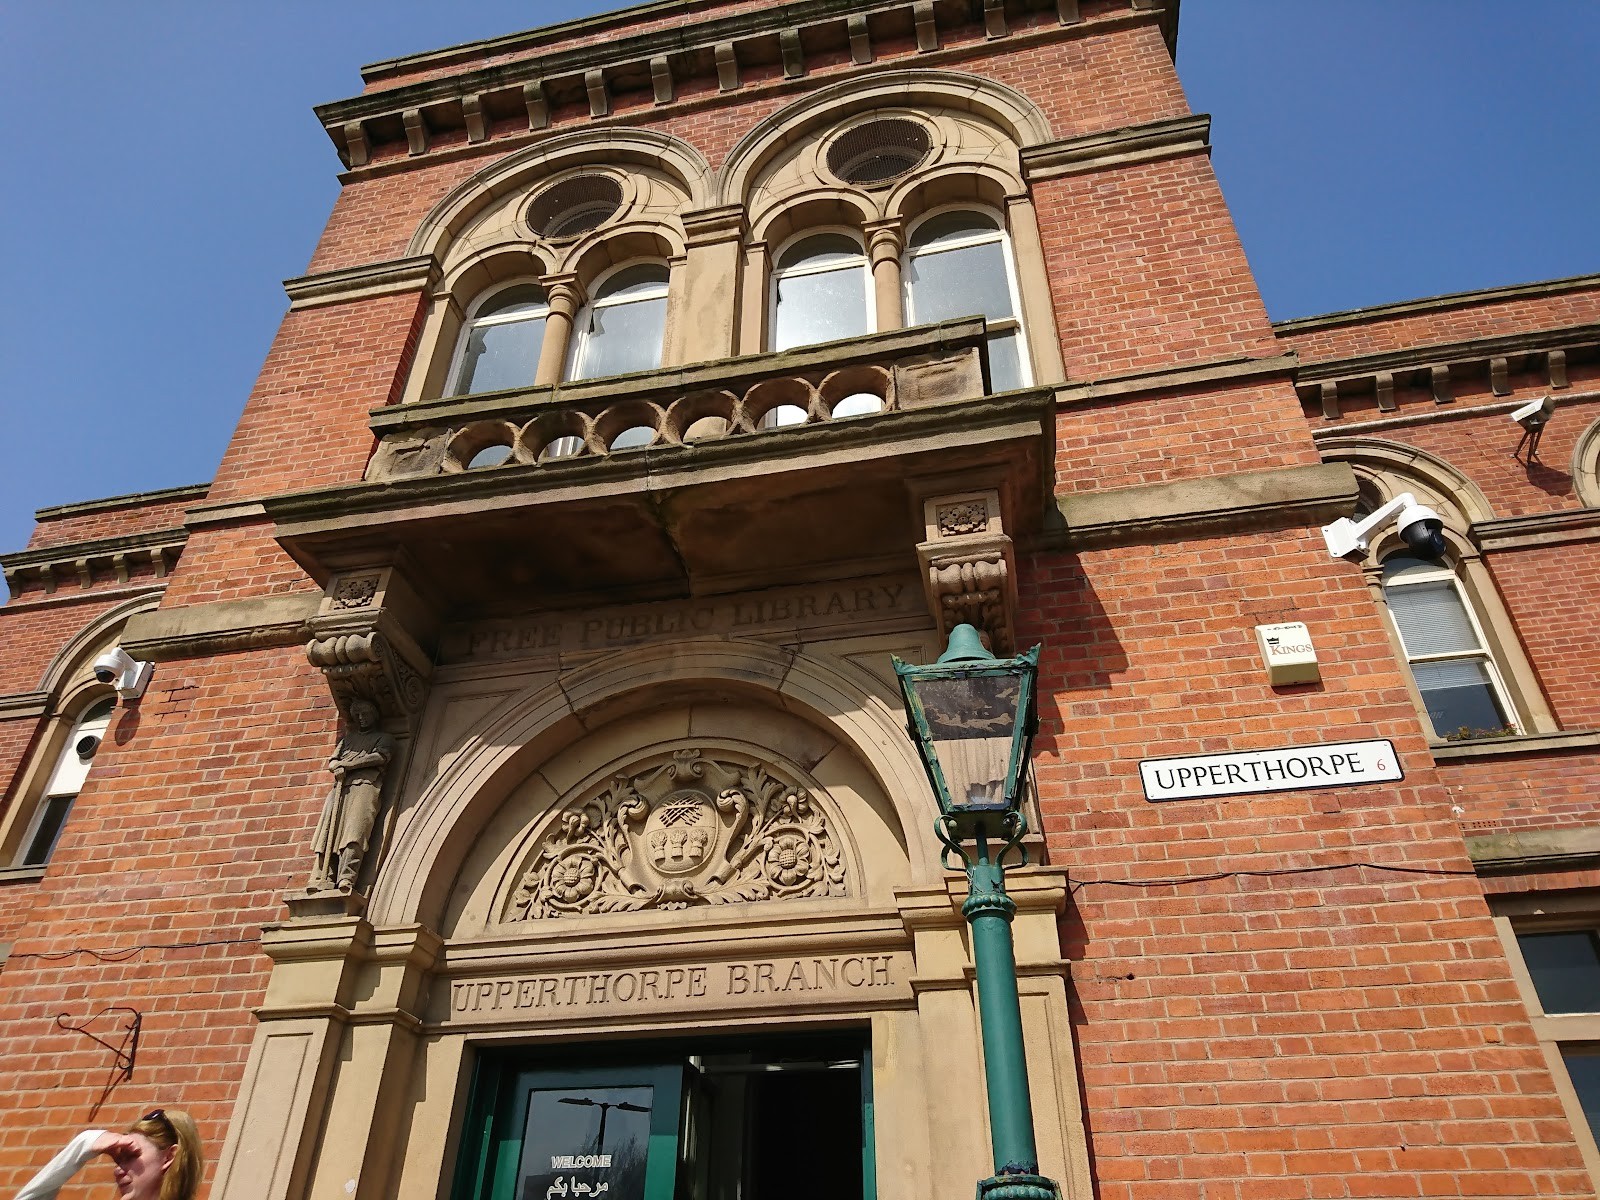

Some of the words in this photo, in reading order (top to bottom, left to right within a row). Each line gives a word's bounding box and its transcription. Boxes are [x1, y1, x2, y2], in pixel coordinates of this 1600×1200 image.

[465, 624, 562, 655] FREE
[578, 607, 715, 645] PUBLIC
[731, 583, 904, 627] LIBRARY
[1269, 643, 1313, 656] KINGS
[1154, 751, 1365, 790] UPPERTHORPE
[1376, 758, 1387, 771] 6
[451, 966, 708, 1013] UPPERTHORPE
[726, 955, 896, 996] BRANCH
[551, 1154, 612, 1169] WELCOME
[546, 1175, 569, 1200] بكم
[570, 1175, 609, 1198] مرحبا
